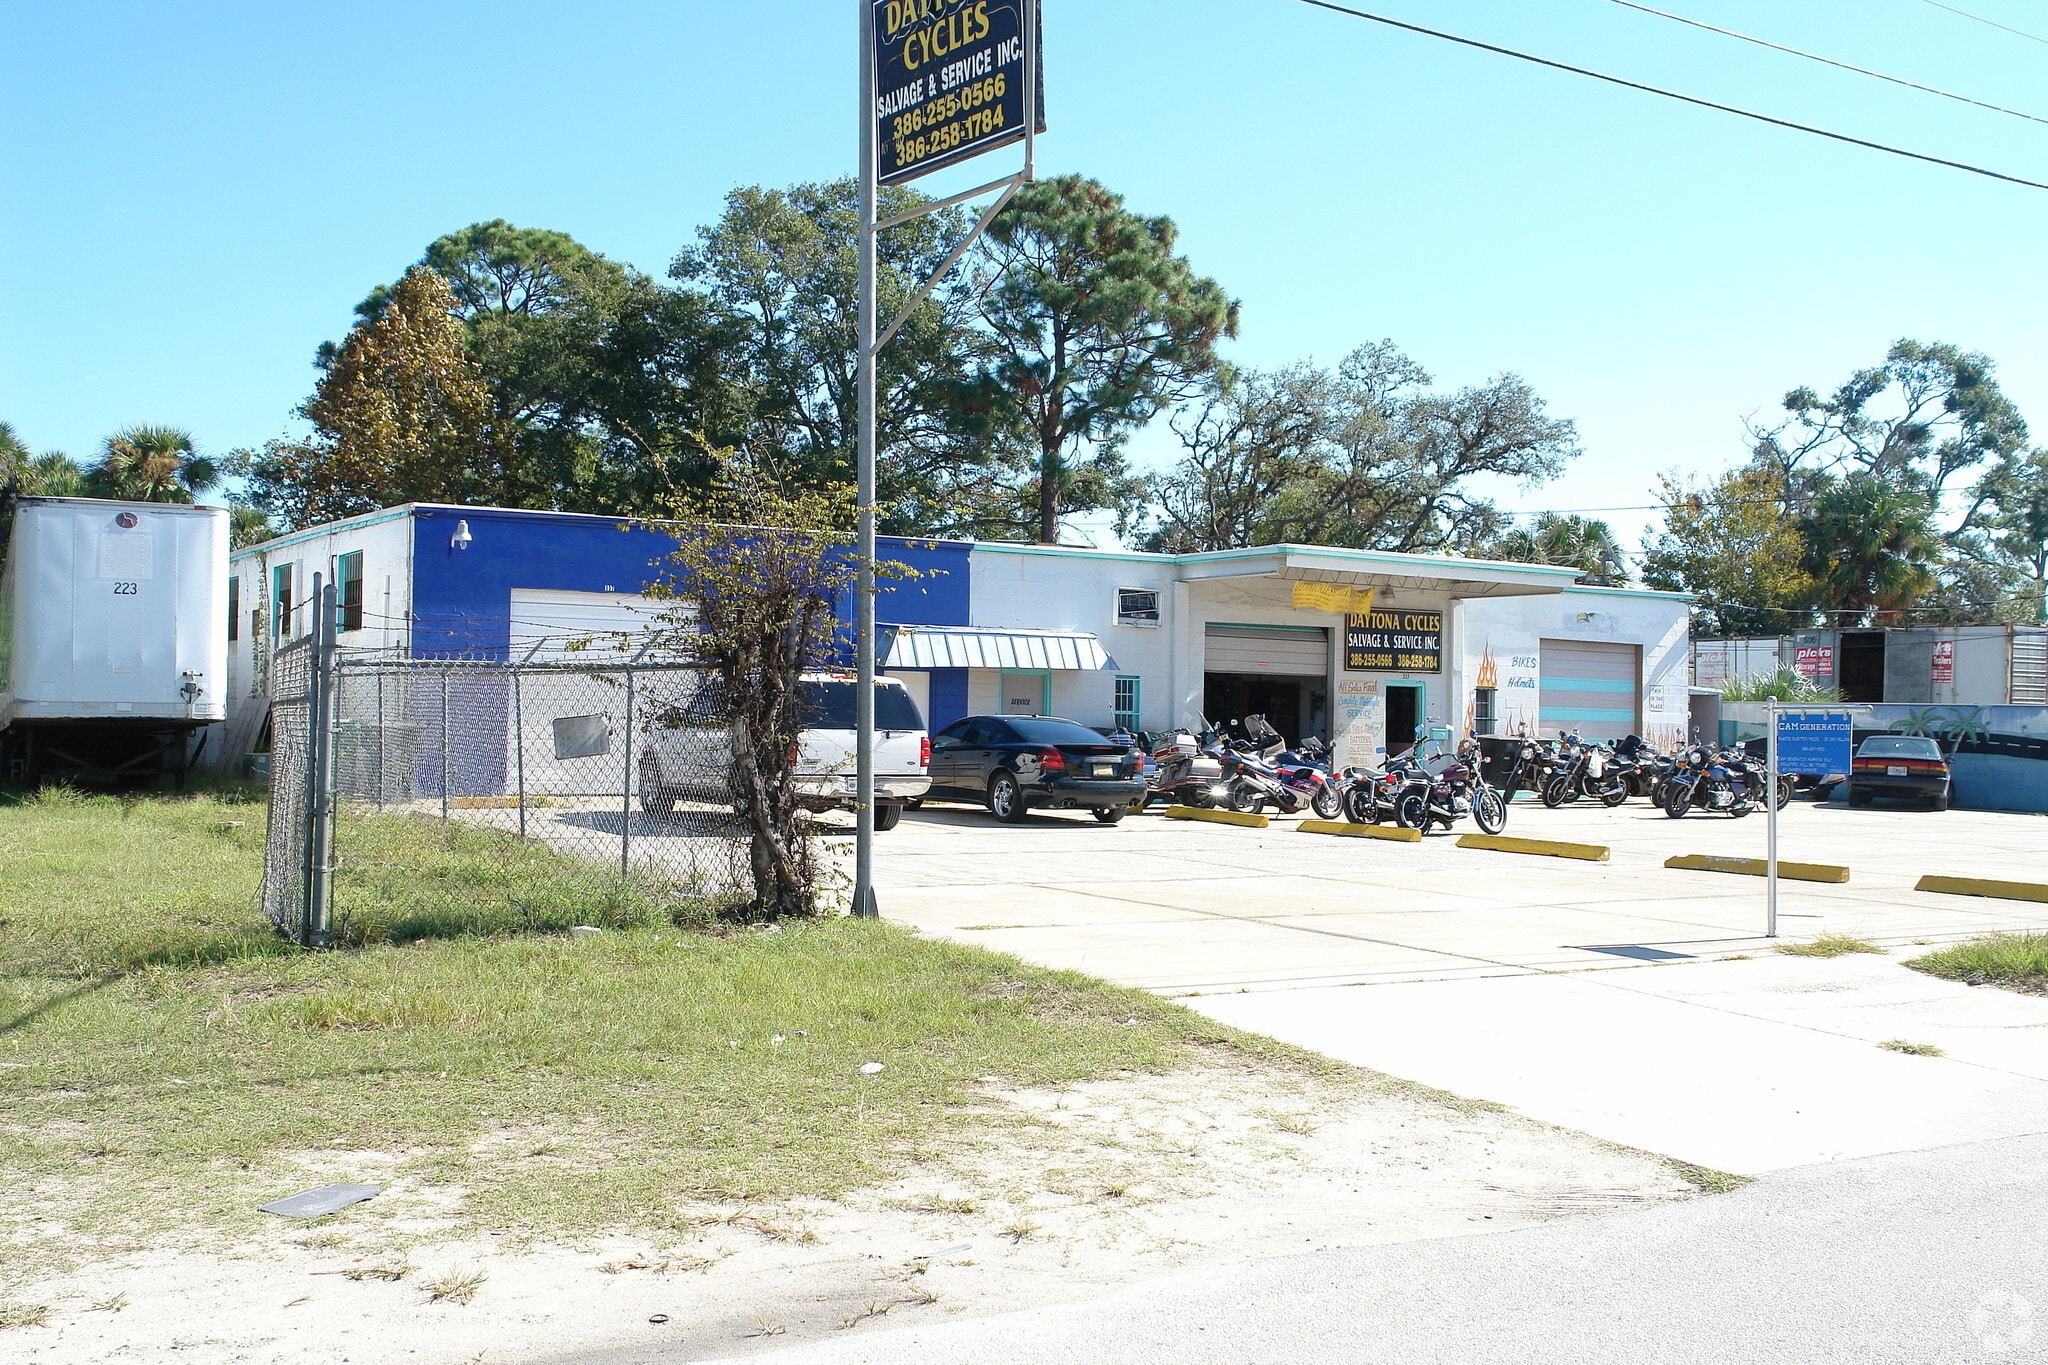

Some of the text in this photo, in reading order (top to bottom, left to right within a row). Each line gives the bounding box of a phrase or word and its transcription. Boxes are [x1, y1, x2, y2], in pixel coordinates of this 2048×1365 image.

[903, 1, 990, 71] CYCLES
[878, 35, 1023, 119] SALVAGE & SERVICE INC.
[893, 72, 1006, 140] 386-255-0566
[896, 104, 1004, 167] 386-258-1784
[113, 582, 138, 595] 223
[1350, 613, 1440, 632] DAYTONA CYCLES
[1348, 633, 1440, 650] SALVAGE & SERVICE INC.
[1350, 653, 1438, 669] 386-255-0566 386-258-1784
[1511, 656, 1537, 669] BIKES
[1338, 680, 1378, 692] All Sales Final
[1011, 698, 1031, 706] SERVICE
[1347, 709, 1372, 718] SERVICE
[1778, 723, 1850, 731] CAM GENERATION
